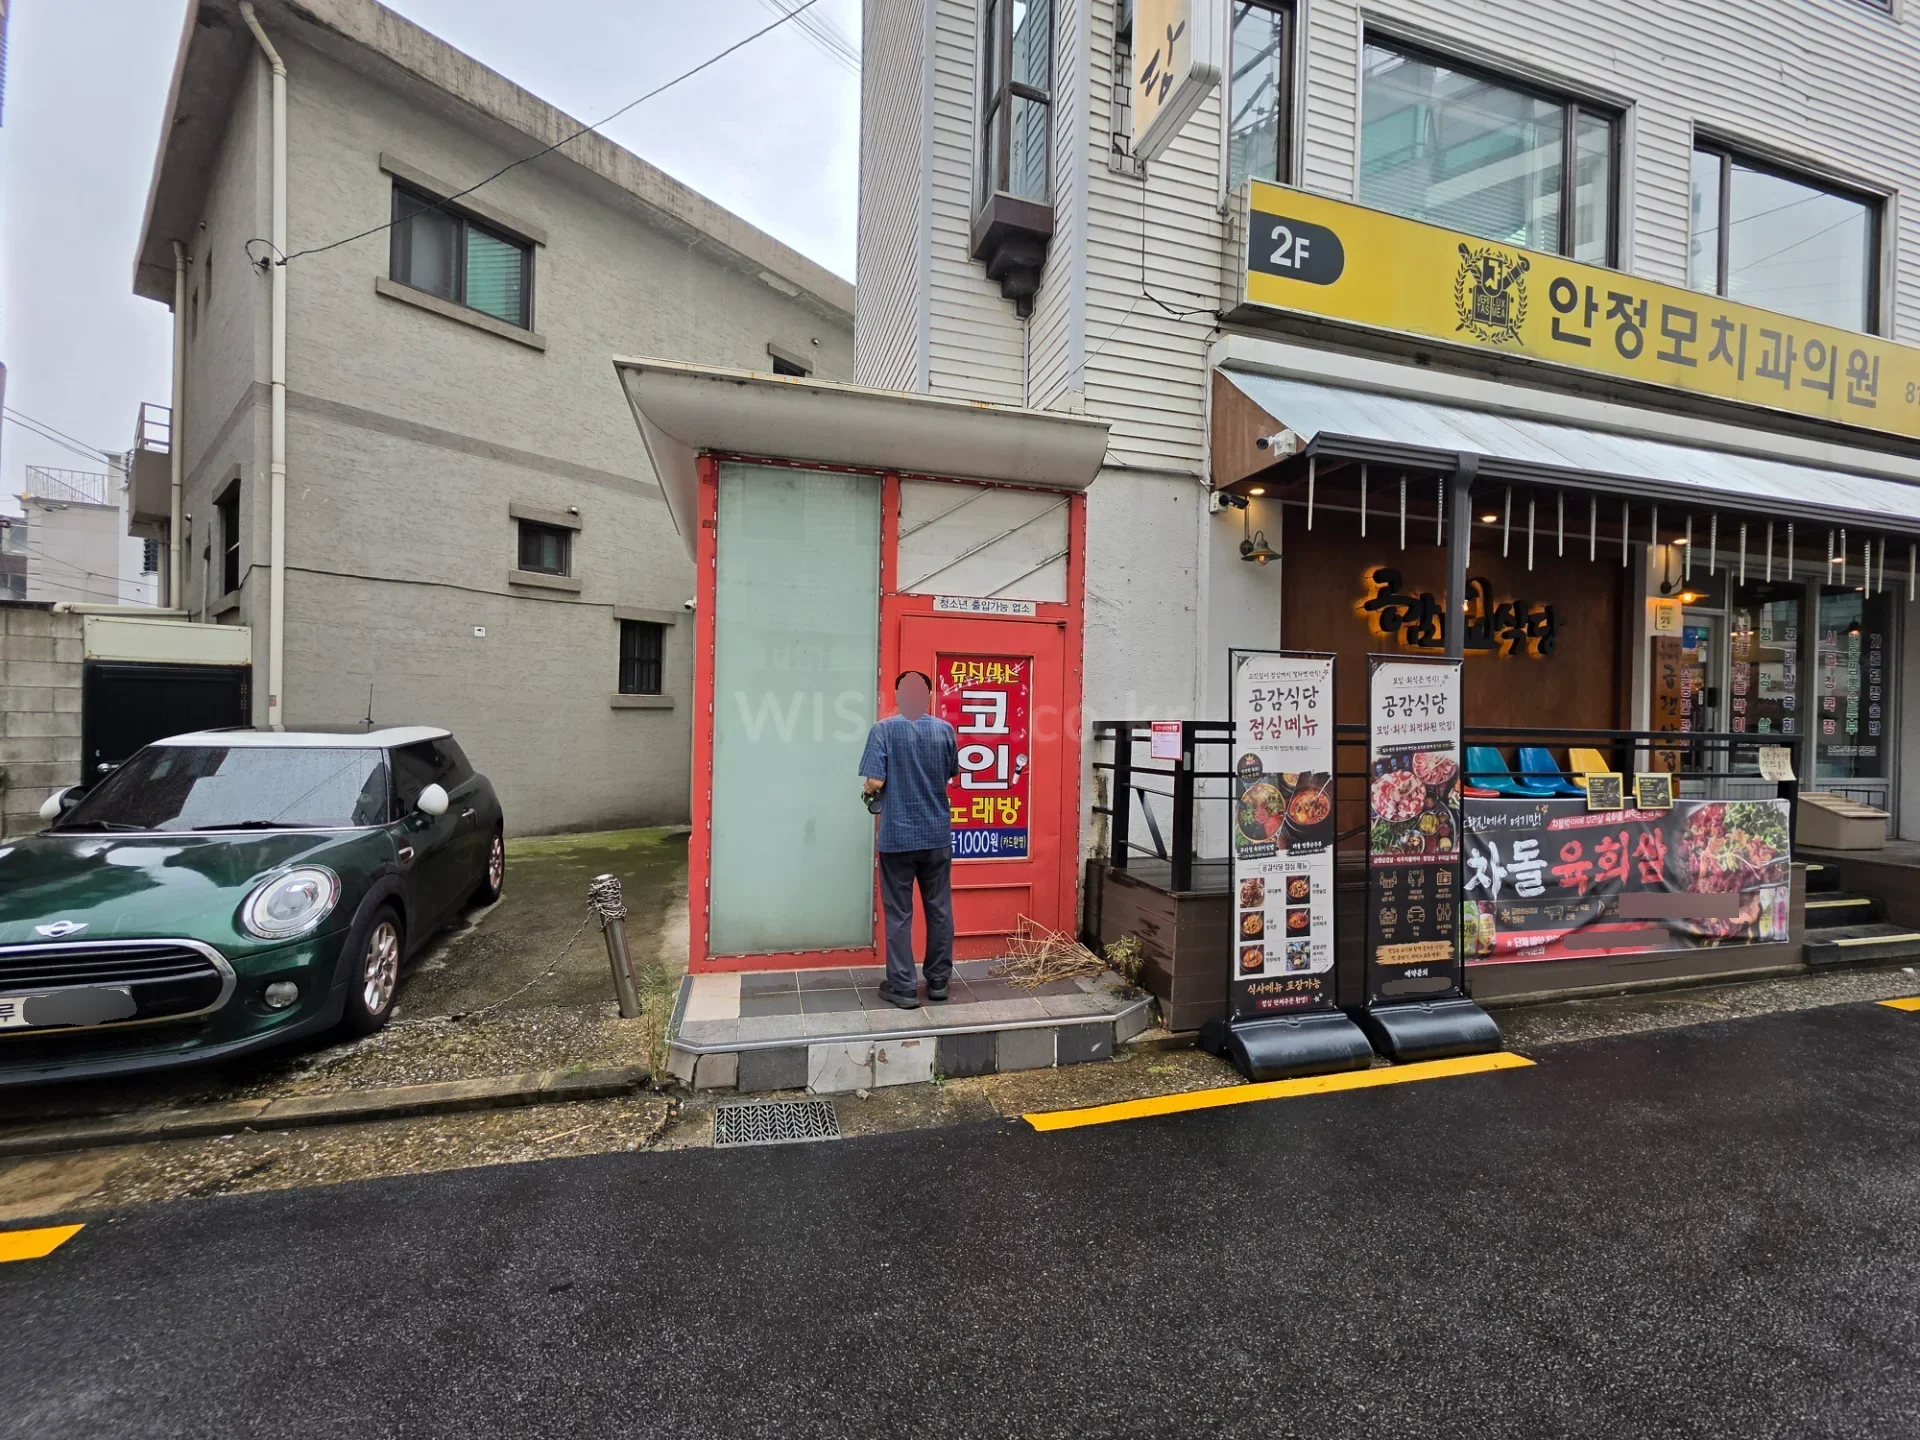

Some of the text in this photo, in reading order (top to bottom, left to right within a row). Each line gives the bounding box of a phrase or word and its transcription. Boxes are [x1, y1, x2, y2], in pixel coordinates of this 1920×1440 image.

[1270, 225, 1310, 269] 2F
[1548, 276, 1880, 409] 안정모치과의원
[971, 599, 1009, 613] 출입가능
[1012, 602, 1030, 613] 업소
[950, 660, 1020, 684] 뮤직박스
[1249, 685, 1319, 712] 공감식당
[1382, 692, 1448, 718] 공감식당
[1249, 714, 1319, 741] 점심메뉴
[1409, 721, 1437, 734] 최적화된
[1510, 811, 1542, 827] 여기만!
[1551, 816, 1585, 829] 차돌박이에
[1262, 863, 1283, 872] 공감식당
[1551, 827, 1668, 897] 육회쌈
[1247, 977, 1322, 996] 식사메뉴 포장가능
